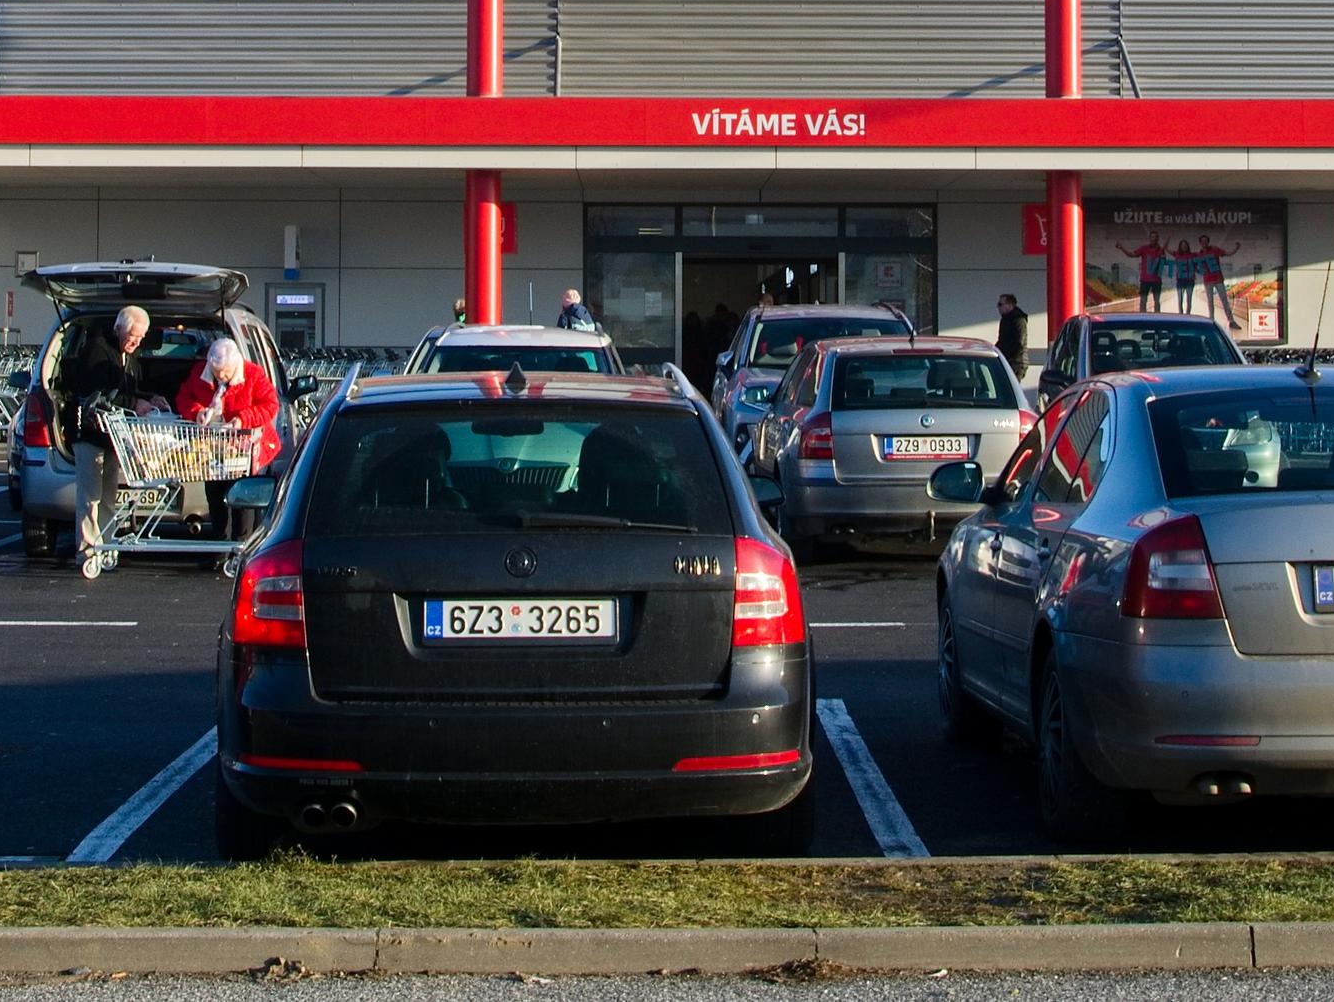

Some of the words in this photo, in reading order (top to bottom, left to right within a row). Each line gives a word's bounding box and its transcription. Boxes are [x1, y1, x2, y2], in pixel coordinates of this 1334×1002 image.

[692, 108, 796, 136] VÍTÁME
[804, 108, 866, 136] VÁS!
[1114, 209, 1163, 224] UŽIJTE
[1195, 210, 1252, 224] NÁKUP!
[895, 439, 920, 453] 2Z9
[929, 439, 962, 452] 0933
[1319, 591, 1334, 601] CZ
[449, 605, 504, 634] 6Z3
[528, 605, 601, 634] 3265
[427, 625, 441, 635] CZ
